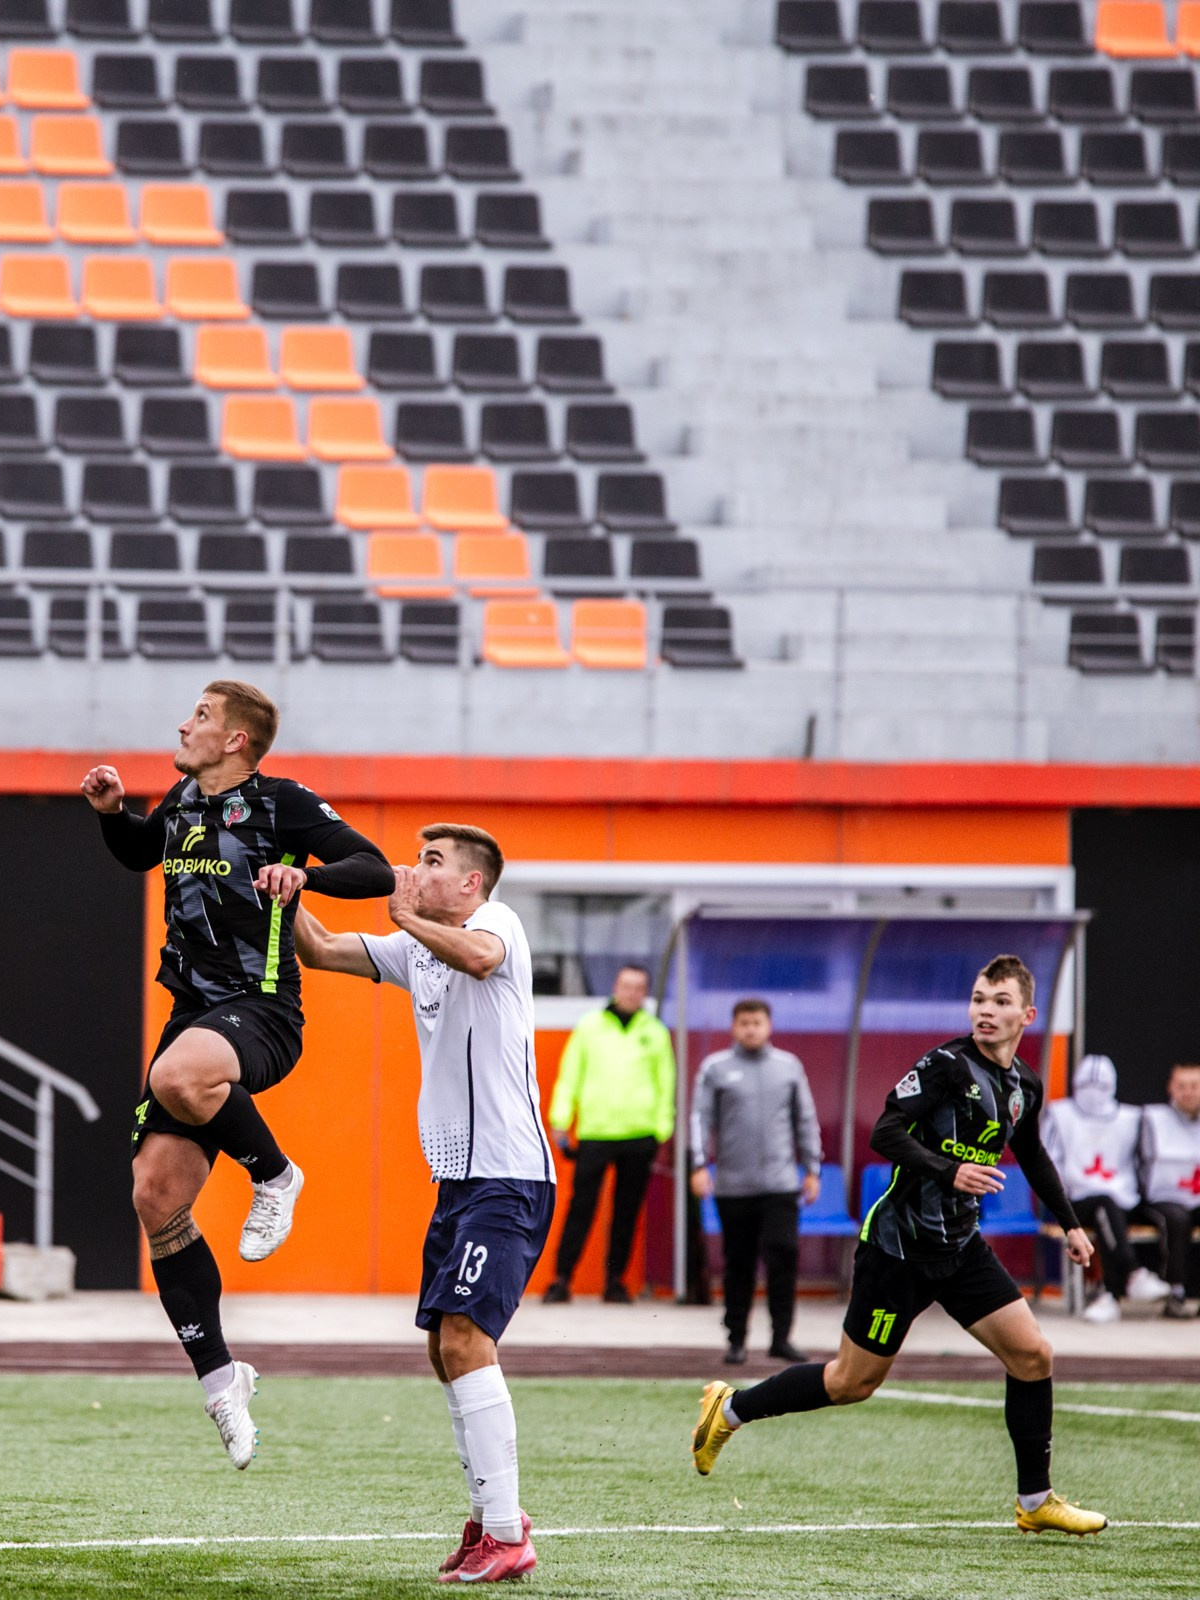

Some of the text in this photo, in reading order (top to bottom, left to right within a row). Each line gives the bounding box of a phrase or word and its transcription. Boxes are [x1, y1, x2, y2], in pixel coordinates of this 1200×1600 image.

[163, 858, 231, 876] ервико
[941, 1138, 1001, 1166] сервик
[458, 1241, 488, 1283] 13
[867, 1308, 897, 1345] 11
